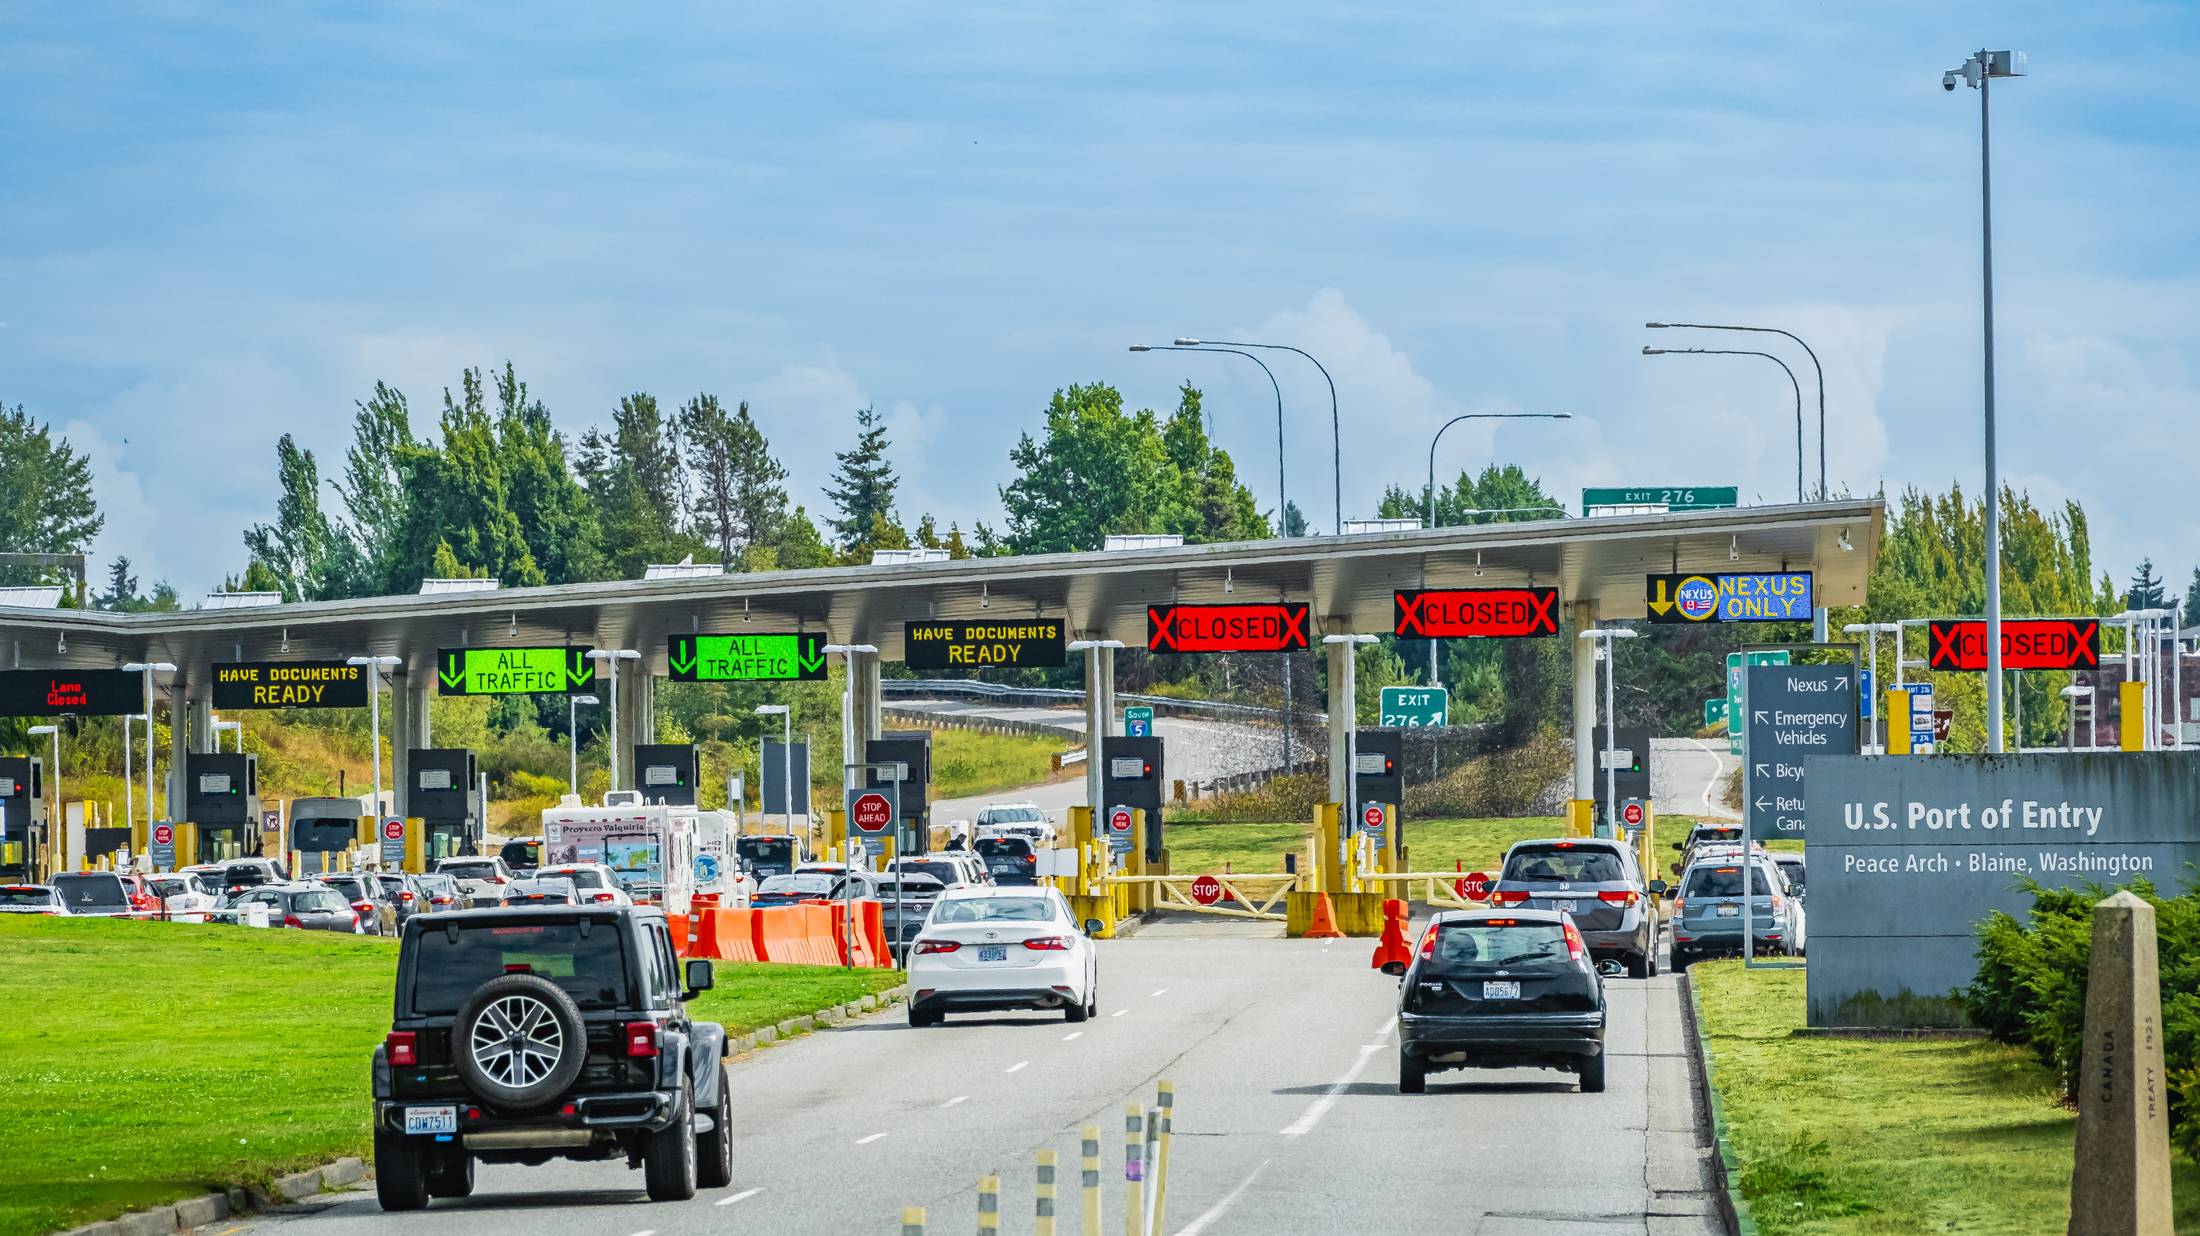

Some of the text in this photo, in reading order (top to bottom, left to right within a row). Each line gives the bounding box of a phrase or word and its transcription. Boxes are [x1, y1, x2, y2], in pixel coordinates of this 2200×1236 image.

[1625, 490, 1694, 503] EXIT 276
[1680, 589, 1714, 600] NEXUS
[1719, 576, 1805, 597] NEXUS
[1425, 602, 1526, 625] CLOSED
[1727, 597, 1796, 617] ONLY
[913, 625, 1057, 641] HAVE DOCUMENTS
[1178, 617, 1279, 640] CLOSED
[729, 639, 765, 657] ALL
[1962, 633, 2066, 656] CLOSED
[497, 652, 534, 670] ALL
[949, 644, 1021, 664] READY
[219, 667, 358, 682] HAVE DOCUMENTS
[708, 658, 787, 677] TRAFFIC
[51, 680, 81, 693] Lane
[477, 671, 557, 690] TRAFFIC
[1787, 677, 1828, 692] Nexus
[47, 692, 87, 706] Closed
[254, 684, 325, 705] READY
[1398, 694, 1430, 706] EXIT
[1385, 714, 1419, 727] 276
[1775, 710, 1848, 729] Emergency
[1135, 725, 1143, 737] 5
[1775, 730, 1827, 745] Vehicles
[862, 802, 882, 811] STOP
[858, 813, 886, 822] AHEAD
[1844, 799, 2104, 836] U.S. Port of Entry
[562, 824, 602, 834] Proyecto
[604, 823, 644, 833] Valquiria
[1845, 852, 2153, 877] Peace Arch Blaine, Washington
[1193, 884, 1219, 896] STOP
[1464, 880, 1483, 893] STO
[2102, 1031, 2114, 1104] CANADA
[2147, 1067, 2155, 1120] TREATY
